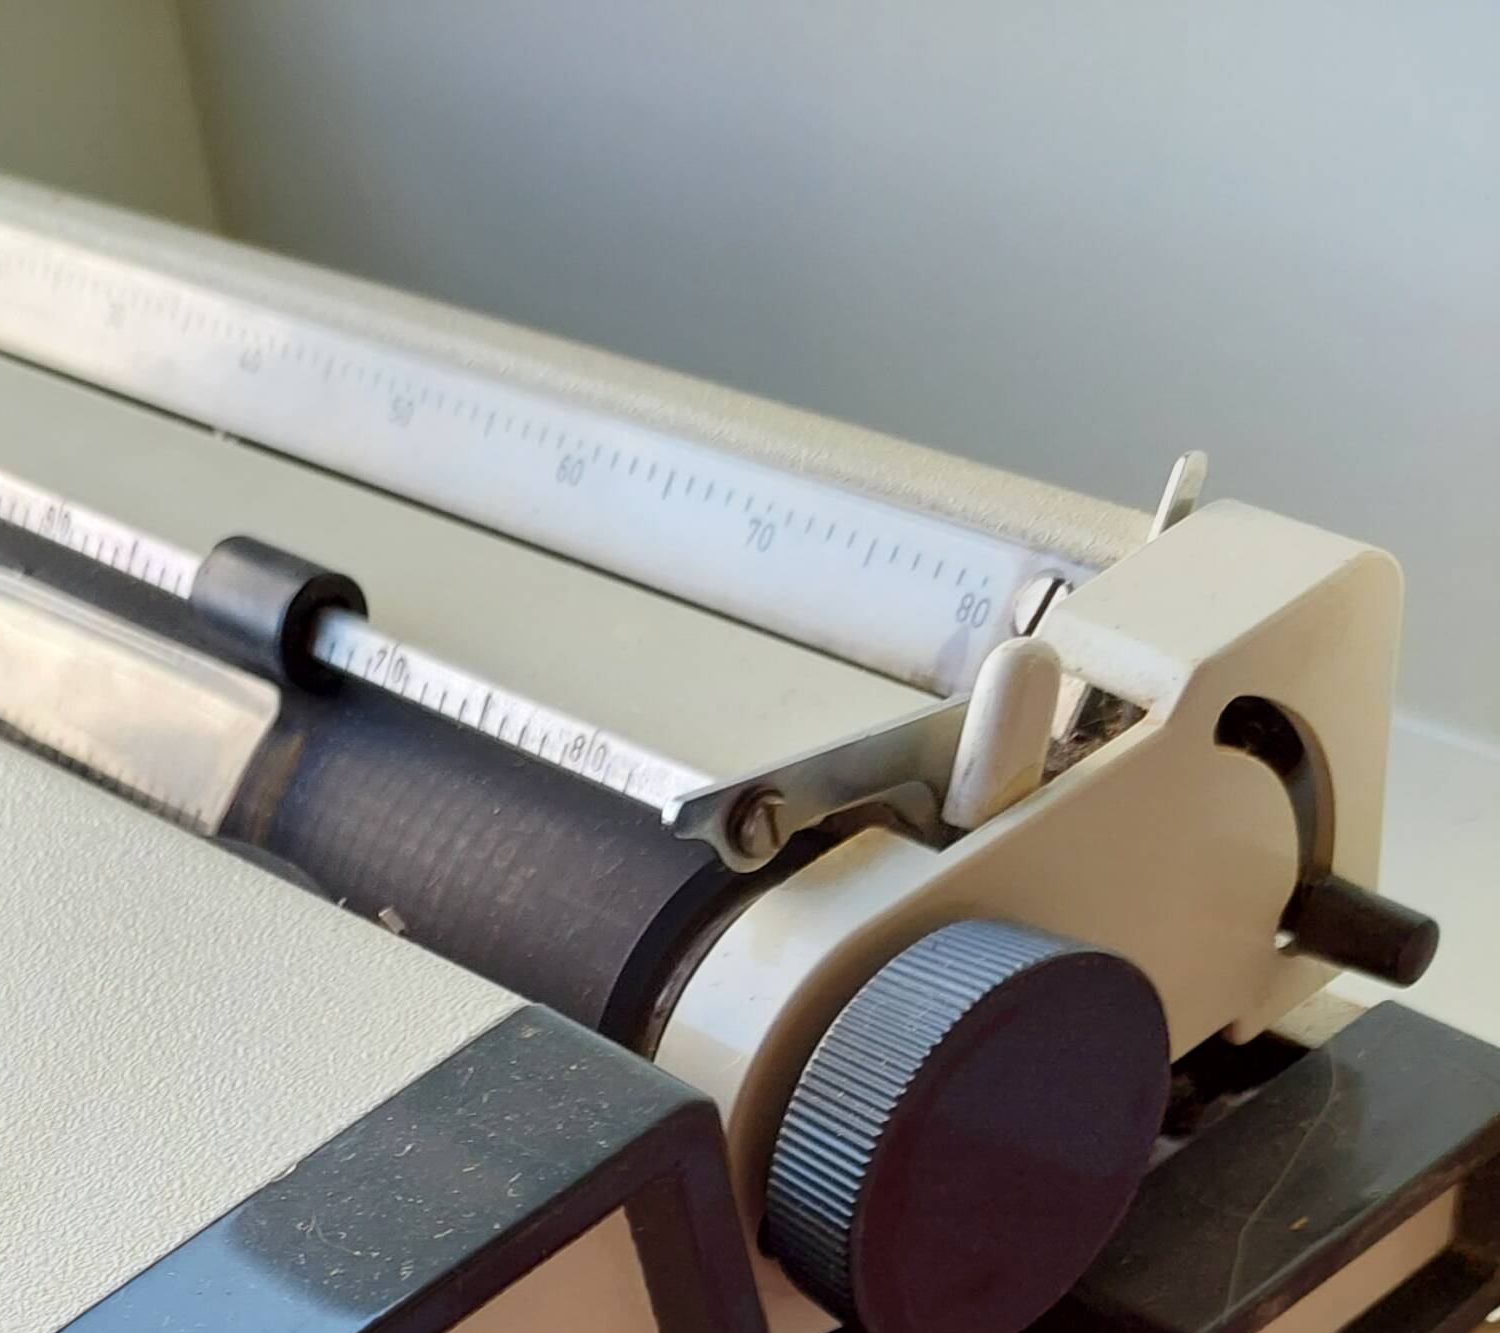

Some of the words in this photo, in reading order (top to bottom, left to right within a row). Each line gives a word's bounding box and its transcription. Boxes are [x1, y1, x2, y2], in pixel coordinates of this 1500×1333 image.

[556, 453, 585, 488] 60
[746, 519, 775, 552] 70
[956, 592, 991, 628] 80
